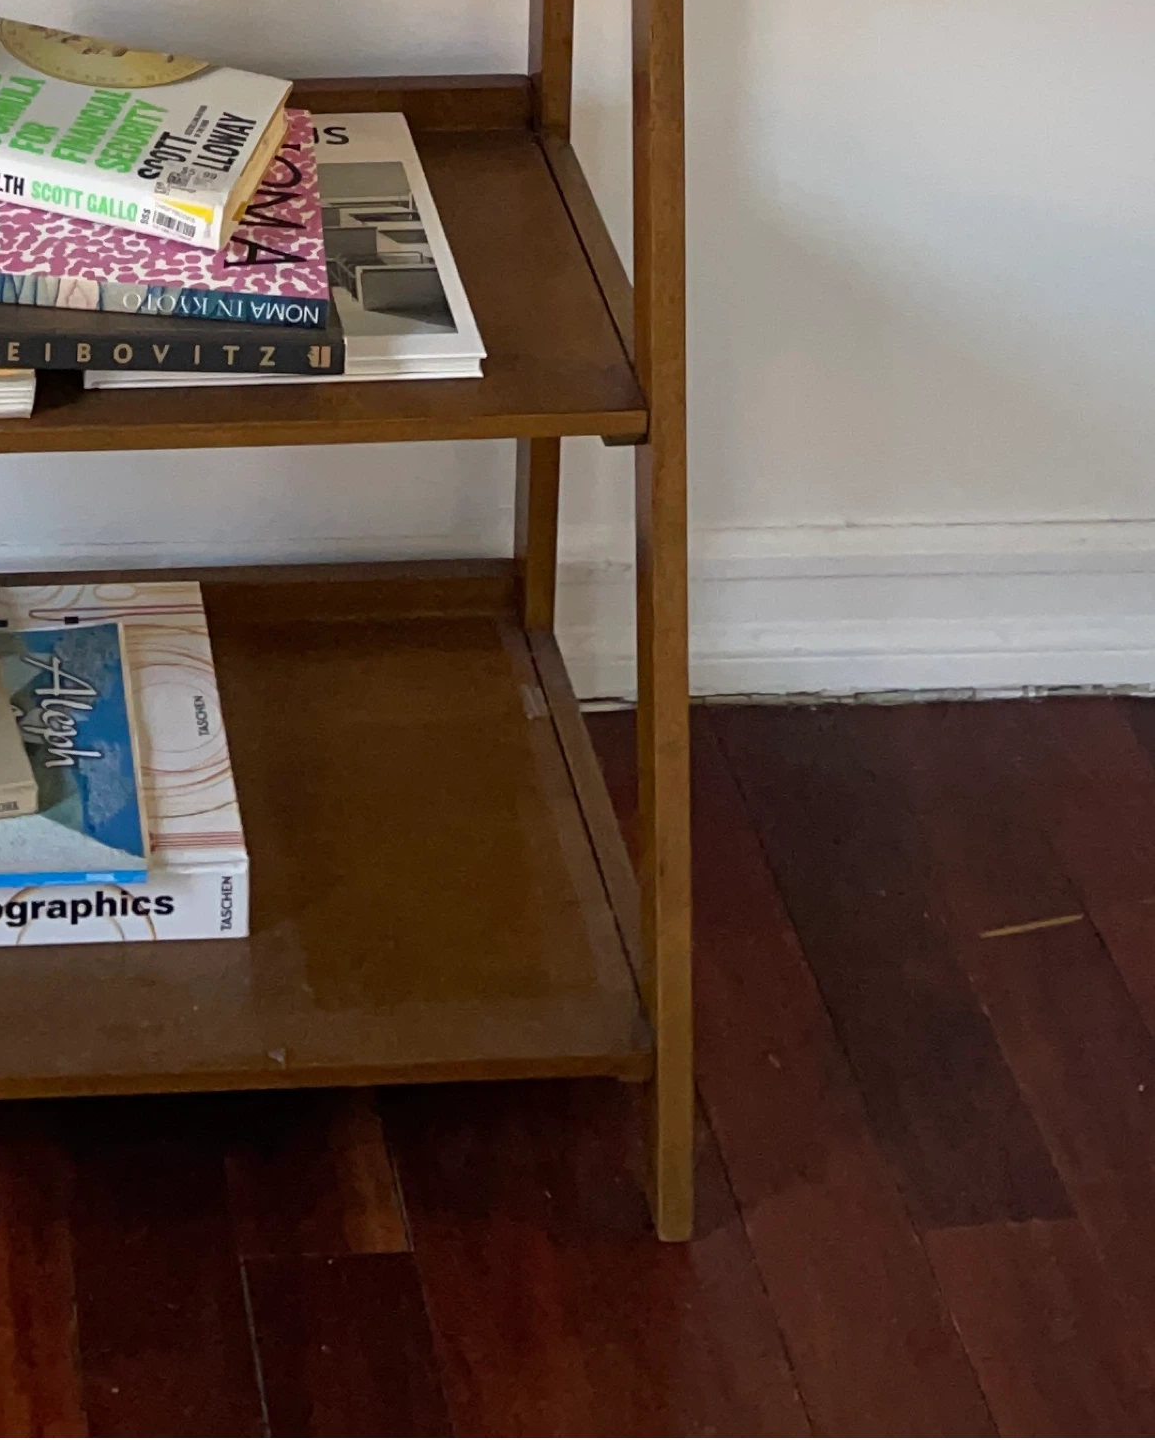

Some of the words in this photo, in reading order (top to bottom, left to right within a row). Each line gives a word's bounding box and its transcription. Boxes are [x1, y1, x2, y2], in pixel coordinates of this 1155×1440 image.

[8, 122, 61, 156] FOR
[51, 89, 132, 164] FINANCIAL
[94, 98, 170, 174] SECURITY
[191, 111, 257, 173] LLOWAY
[30, 180, 84, 211] SCOTT
[87, 193, 139, 223] GALLO
[223, 143, 307, 269] OMA
[122, 291, 208, 316] KYOTO
[217, 299, 244, 318] IN
[249, 300, 320, 325] NOMA
[20, 653, 103, 769] Aleph
[193, 695, 210, 737] TASCHEN
[220, 875, 233, 932] TASCHEN
